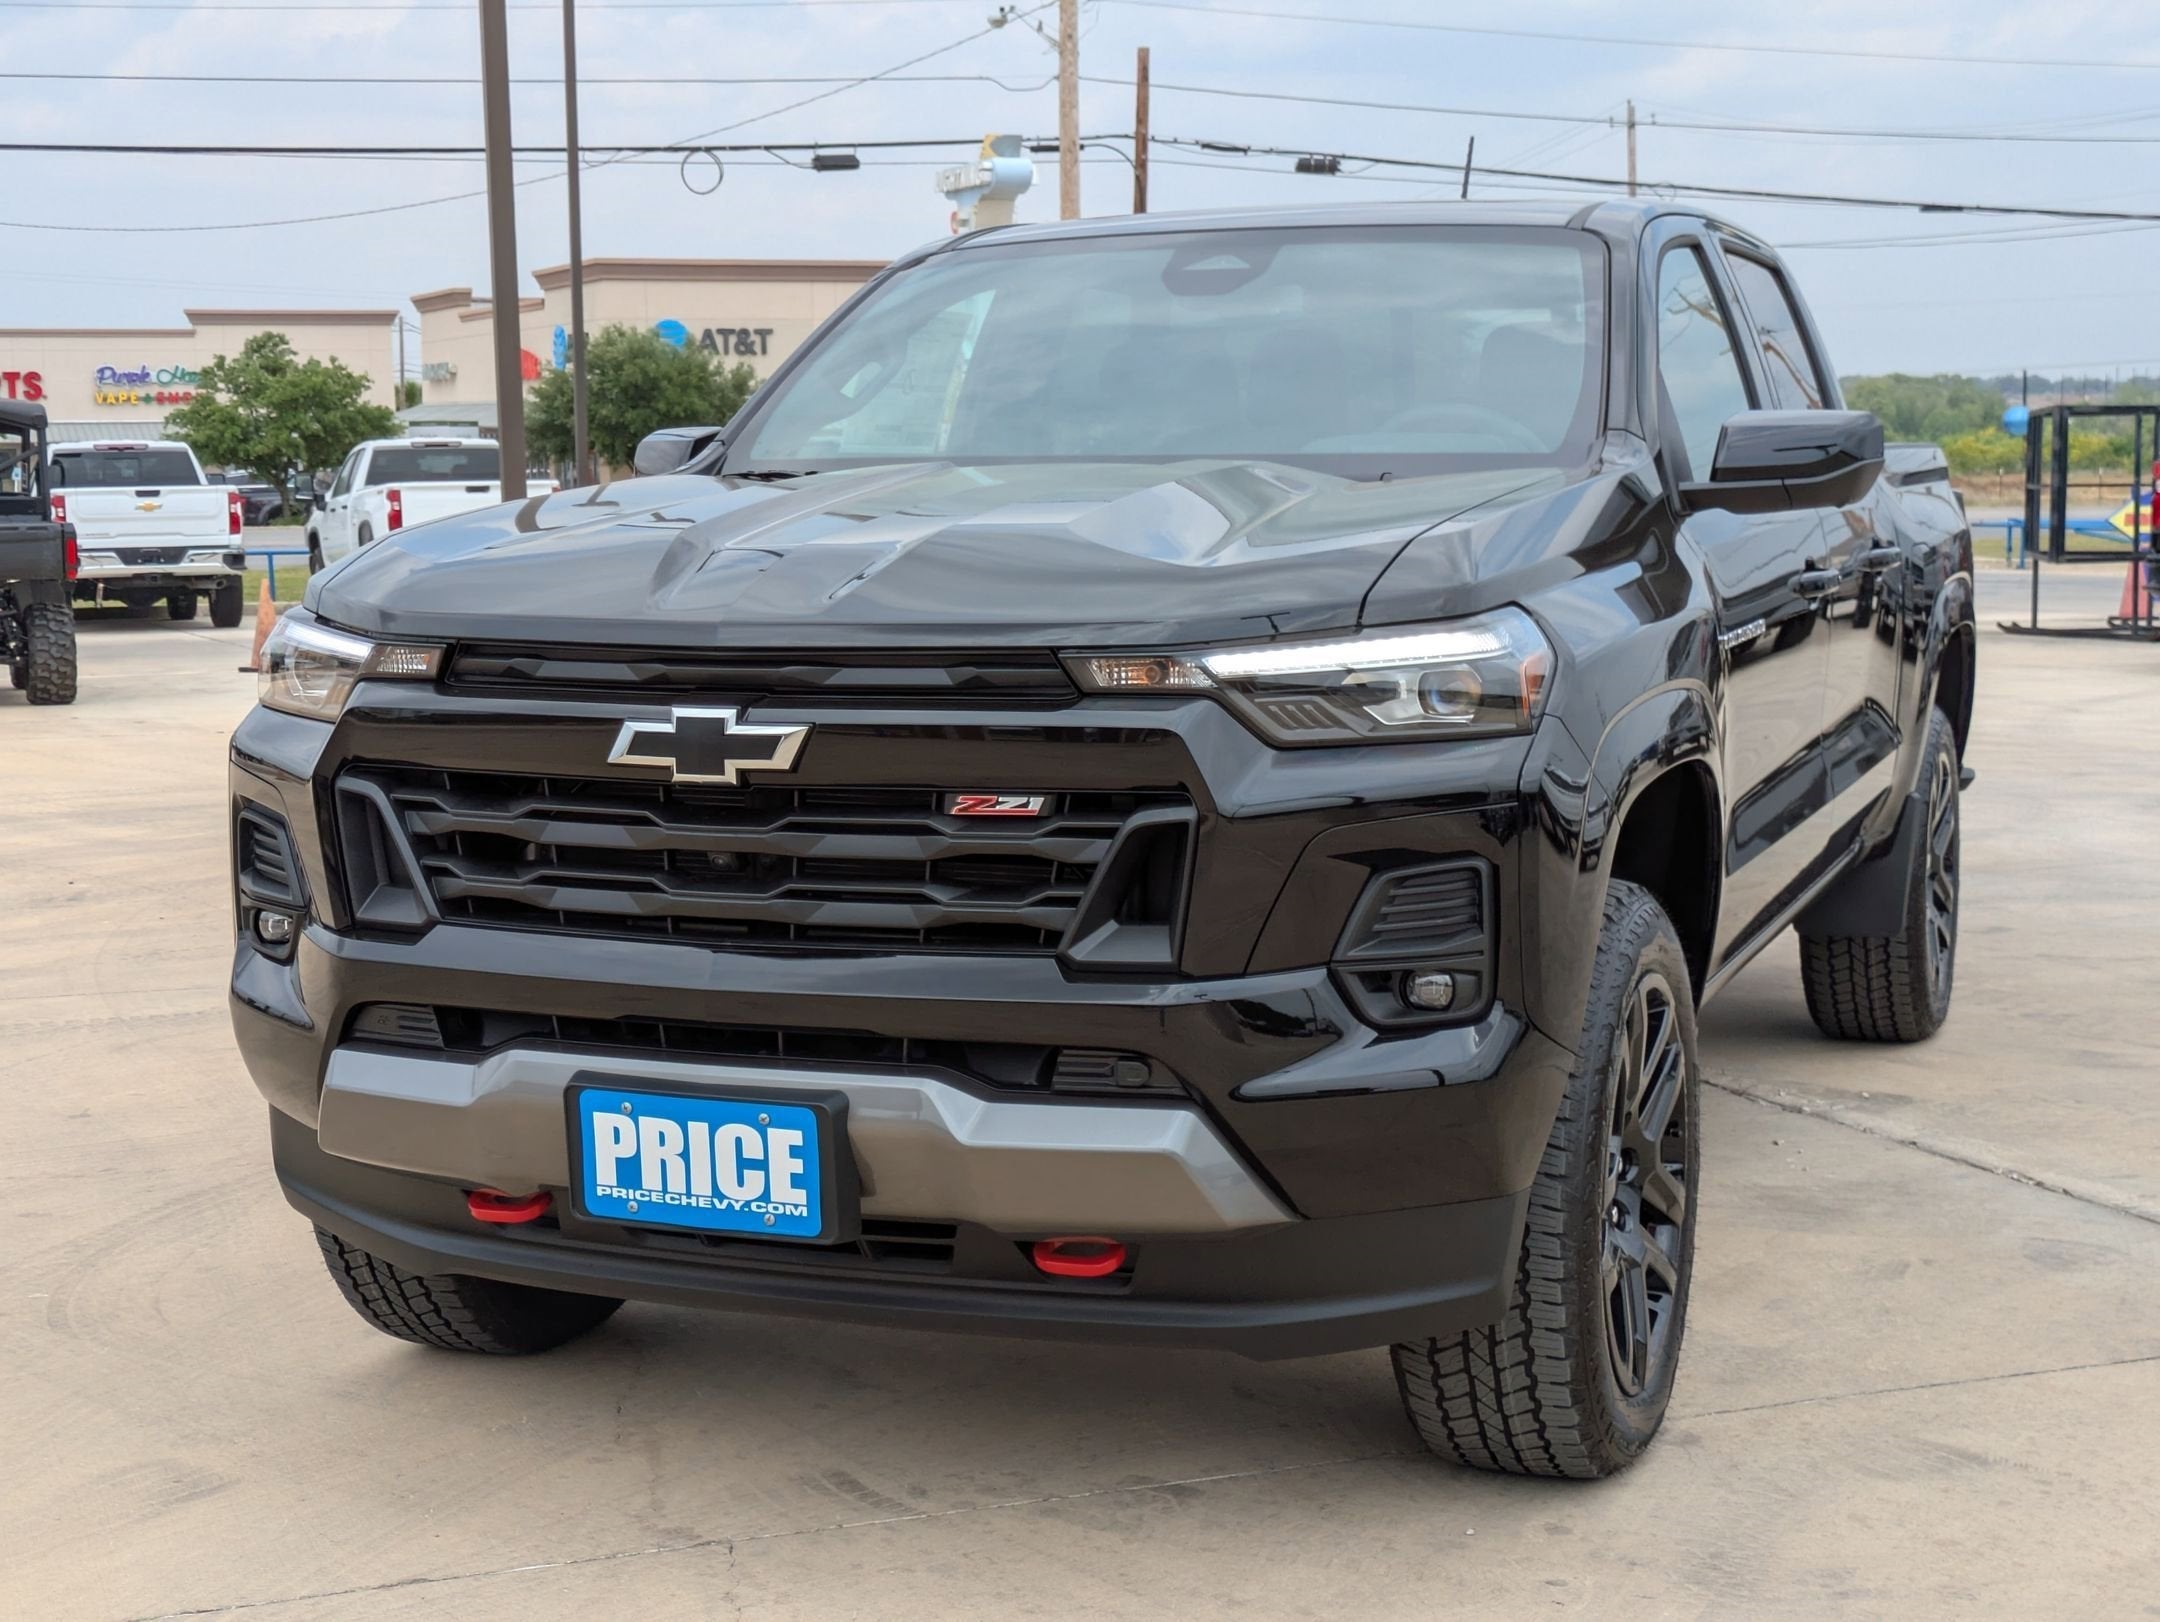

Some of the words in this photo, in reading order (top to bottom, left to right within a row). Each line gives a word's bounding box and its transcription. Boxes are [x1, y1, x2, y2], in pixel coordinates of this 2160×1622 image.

[700, 327, 774, 356] AT&T
[0, 370, 43, 401] TS
[96, 364, 150, 384] Purple
[95, 390, 138, 405] VAPE
[951, 795, 1045, 816] Z71
[592, 1111, 808, 1205] PRICE
[596, 1185, 808, 1217] PRICECHEVY.COM
